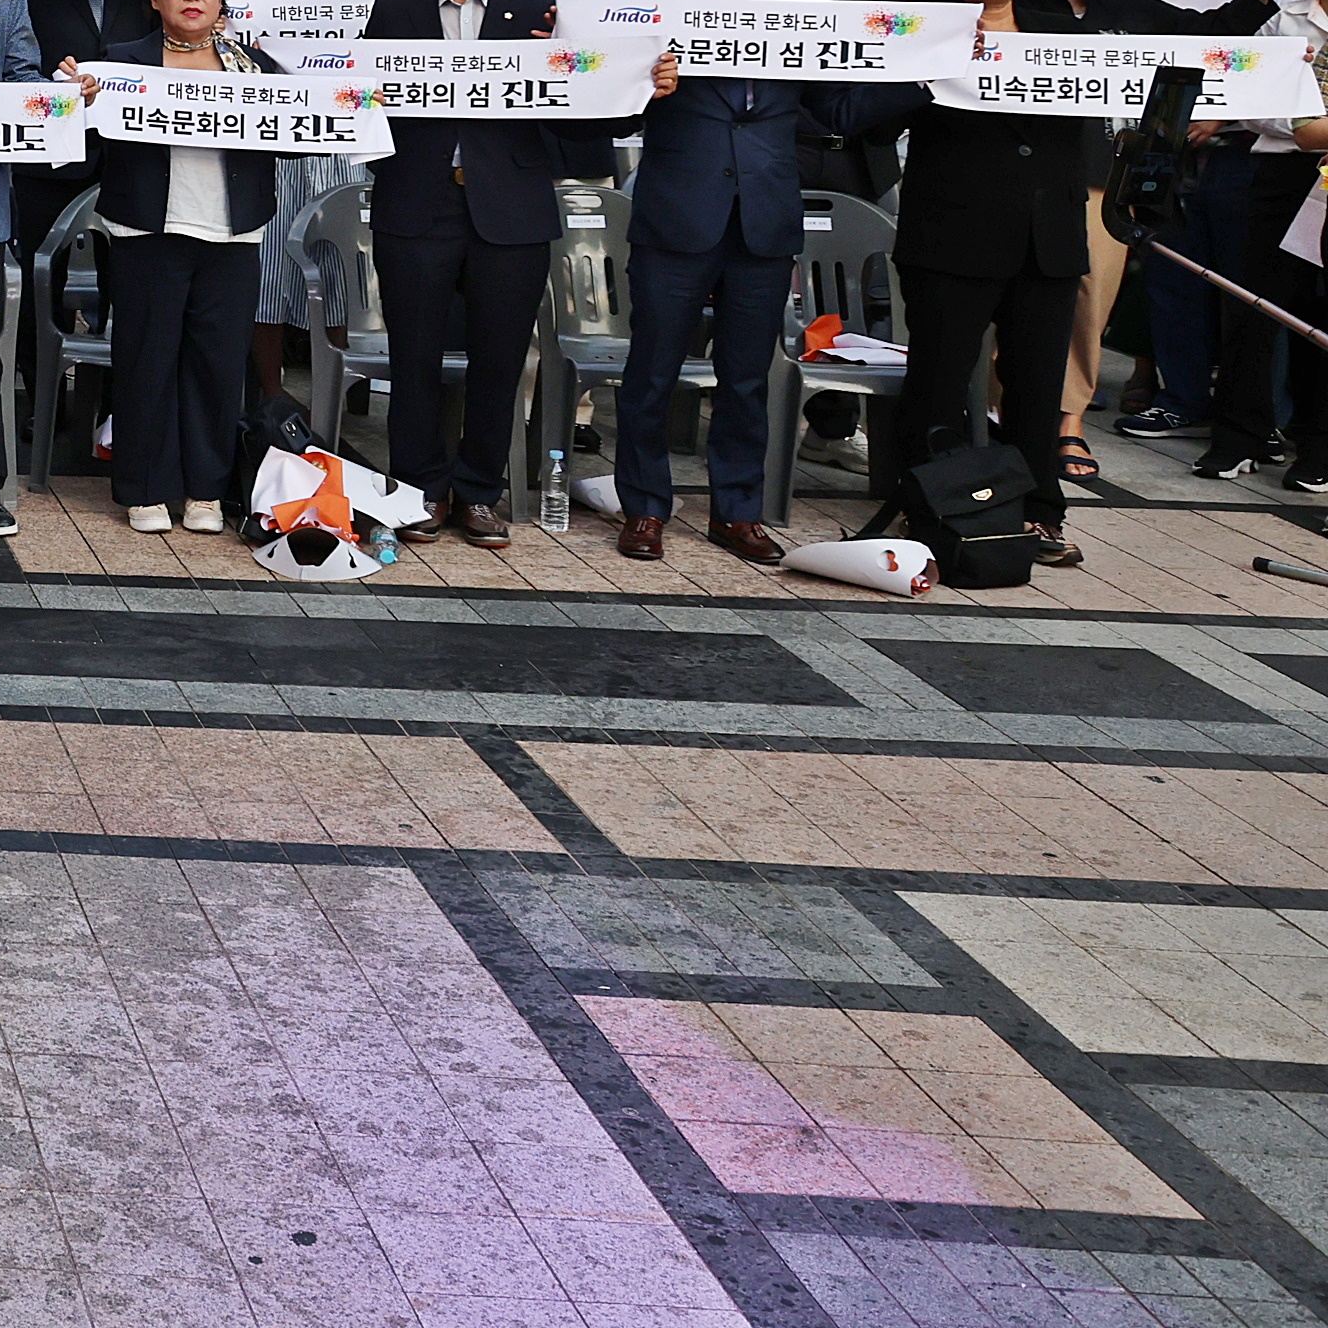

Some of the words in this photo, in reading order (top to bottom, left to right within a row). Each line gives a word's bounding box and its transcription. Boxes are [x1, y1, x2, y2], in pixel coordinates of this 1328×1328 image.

[272, 5, 334, 21] 대한민국
[599, 5, 653, 24] Jindo
[684, 11, 757, 30] 대한민국
[764, 13, 837, 33] 문화도시
[297, 52, 350, 71] Jindo
[375, 55, 445, 73] 대한민국
[450, 54, 521, 73] 문화도시
[779, 41, 804, 68] 섬
[816, 40, 886, 70] 진도
[1025, 48, 1097, 67] 대한민국
[1103, 48, 1176, 69] 문화도시
[168, 83, 236, 102] 대한민국
[241, 87, 309, 107] 문화도시
[467, 84, 490, 108] 섬
[501, 79, 570, 109] 진도
[978, 76, 1109, 105] 민속문화의
[121, 105, 246, 137] 민속문화의
[256, 115, 279, 140] 섬
[289, 113, 357, 143] 진도
